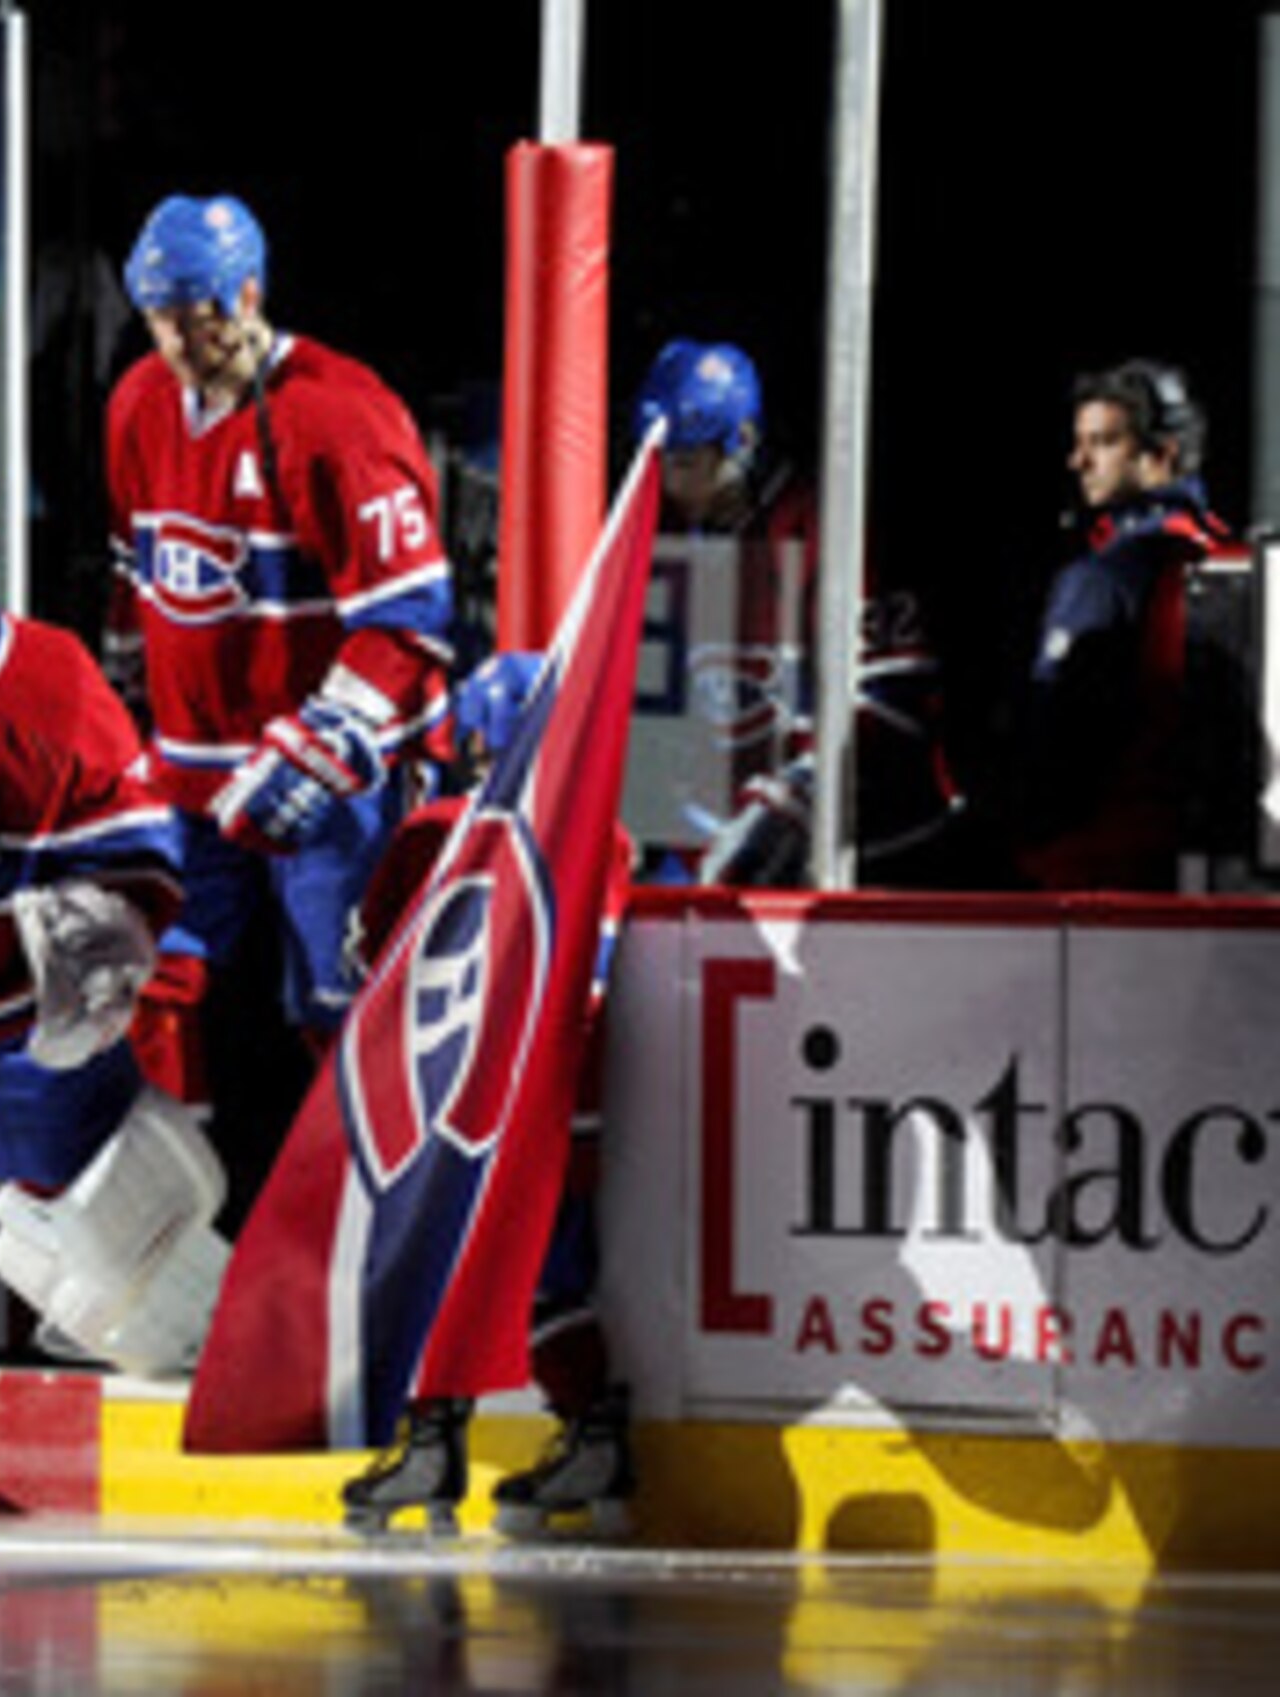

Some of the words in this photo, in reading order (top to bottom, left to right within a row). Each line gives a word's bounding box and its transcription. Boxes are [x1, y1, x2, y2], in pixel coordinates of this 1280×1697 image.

[232, 449, 265, 497] A
[357, 484, 428, 562] 75
[788, 1022, 1280, 1256] intac
[794, 1296, 1268, 1374] ASSURANC
